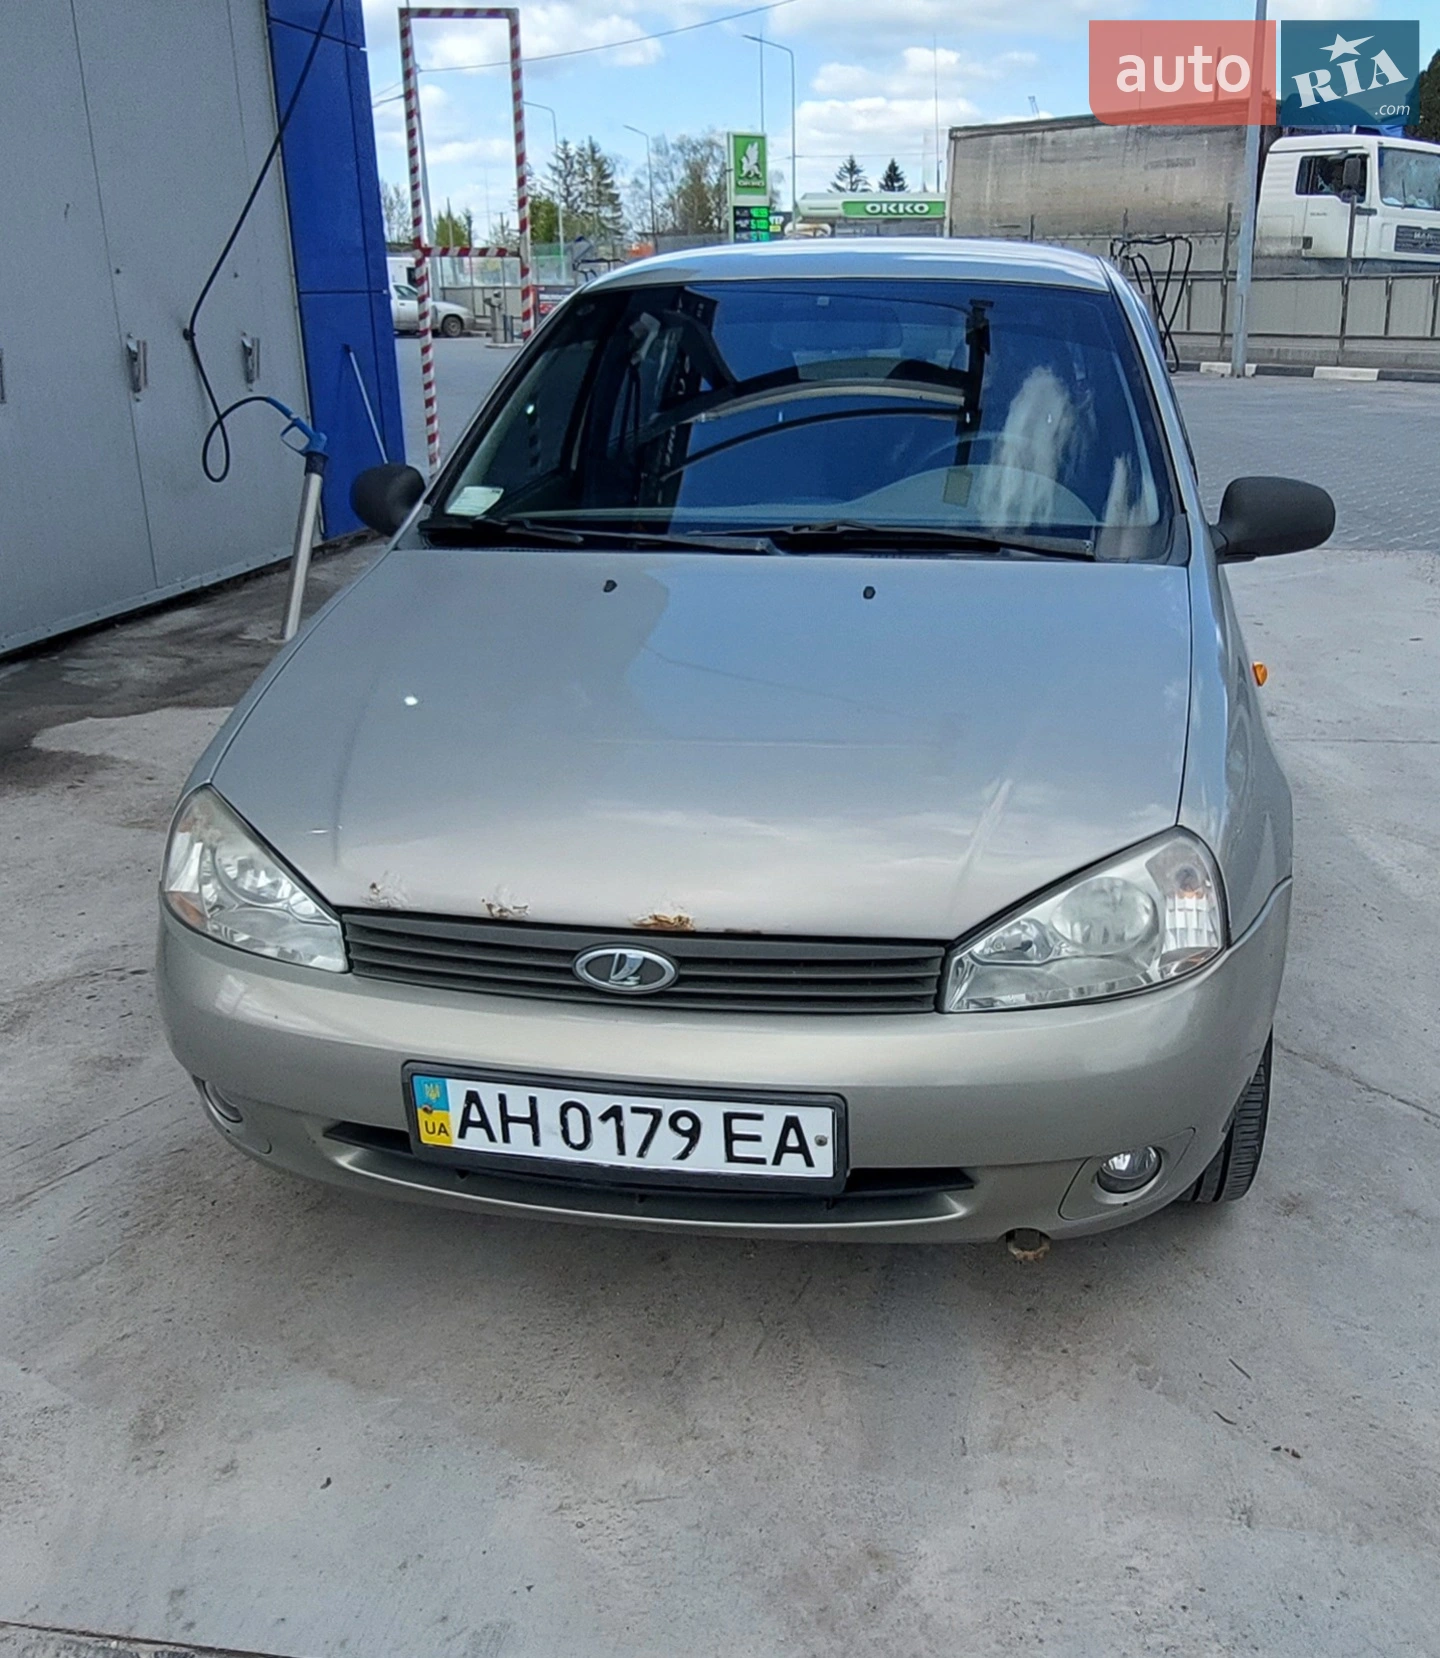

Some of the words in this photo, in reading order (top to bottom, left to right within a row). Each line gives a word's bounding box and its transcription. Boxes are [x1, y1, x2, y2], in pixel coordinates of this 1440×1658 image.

[865, 202, 930, 214] OKKO
[424, 1119, 450, 1139] UA
[457, 1089, 542, 1147] AH
[559, 1101, 702, 1160] 0179
[723, 1111, 815, 1168] EA
